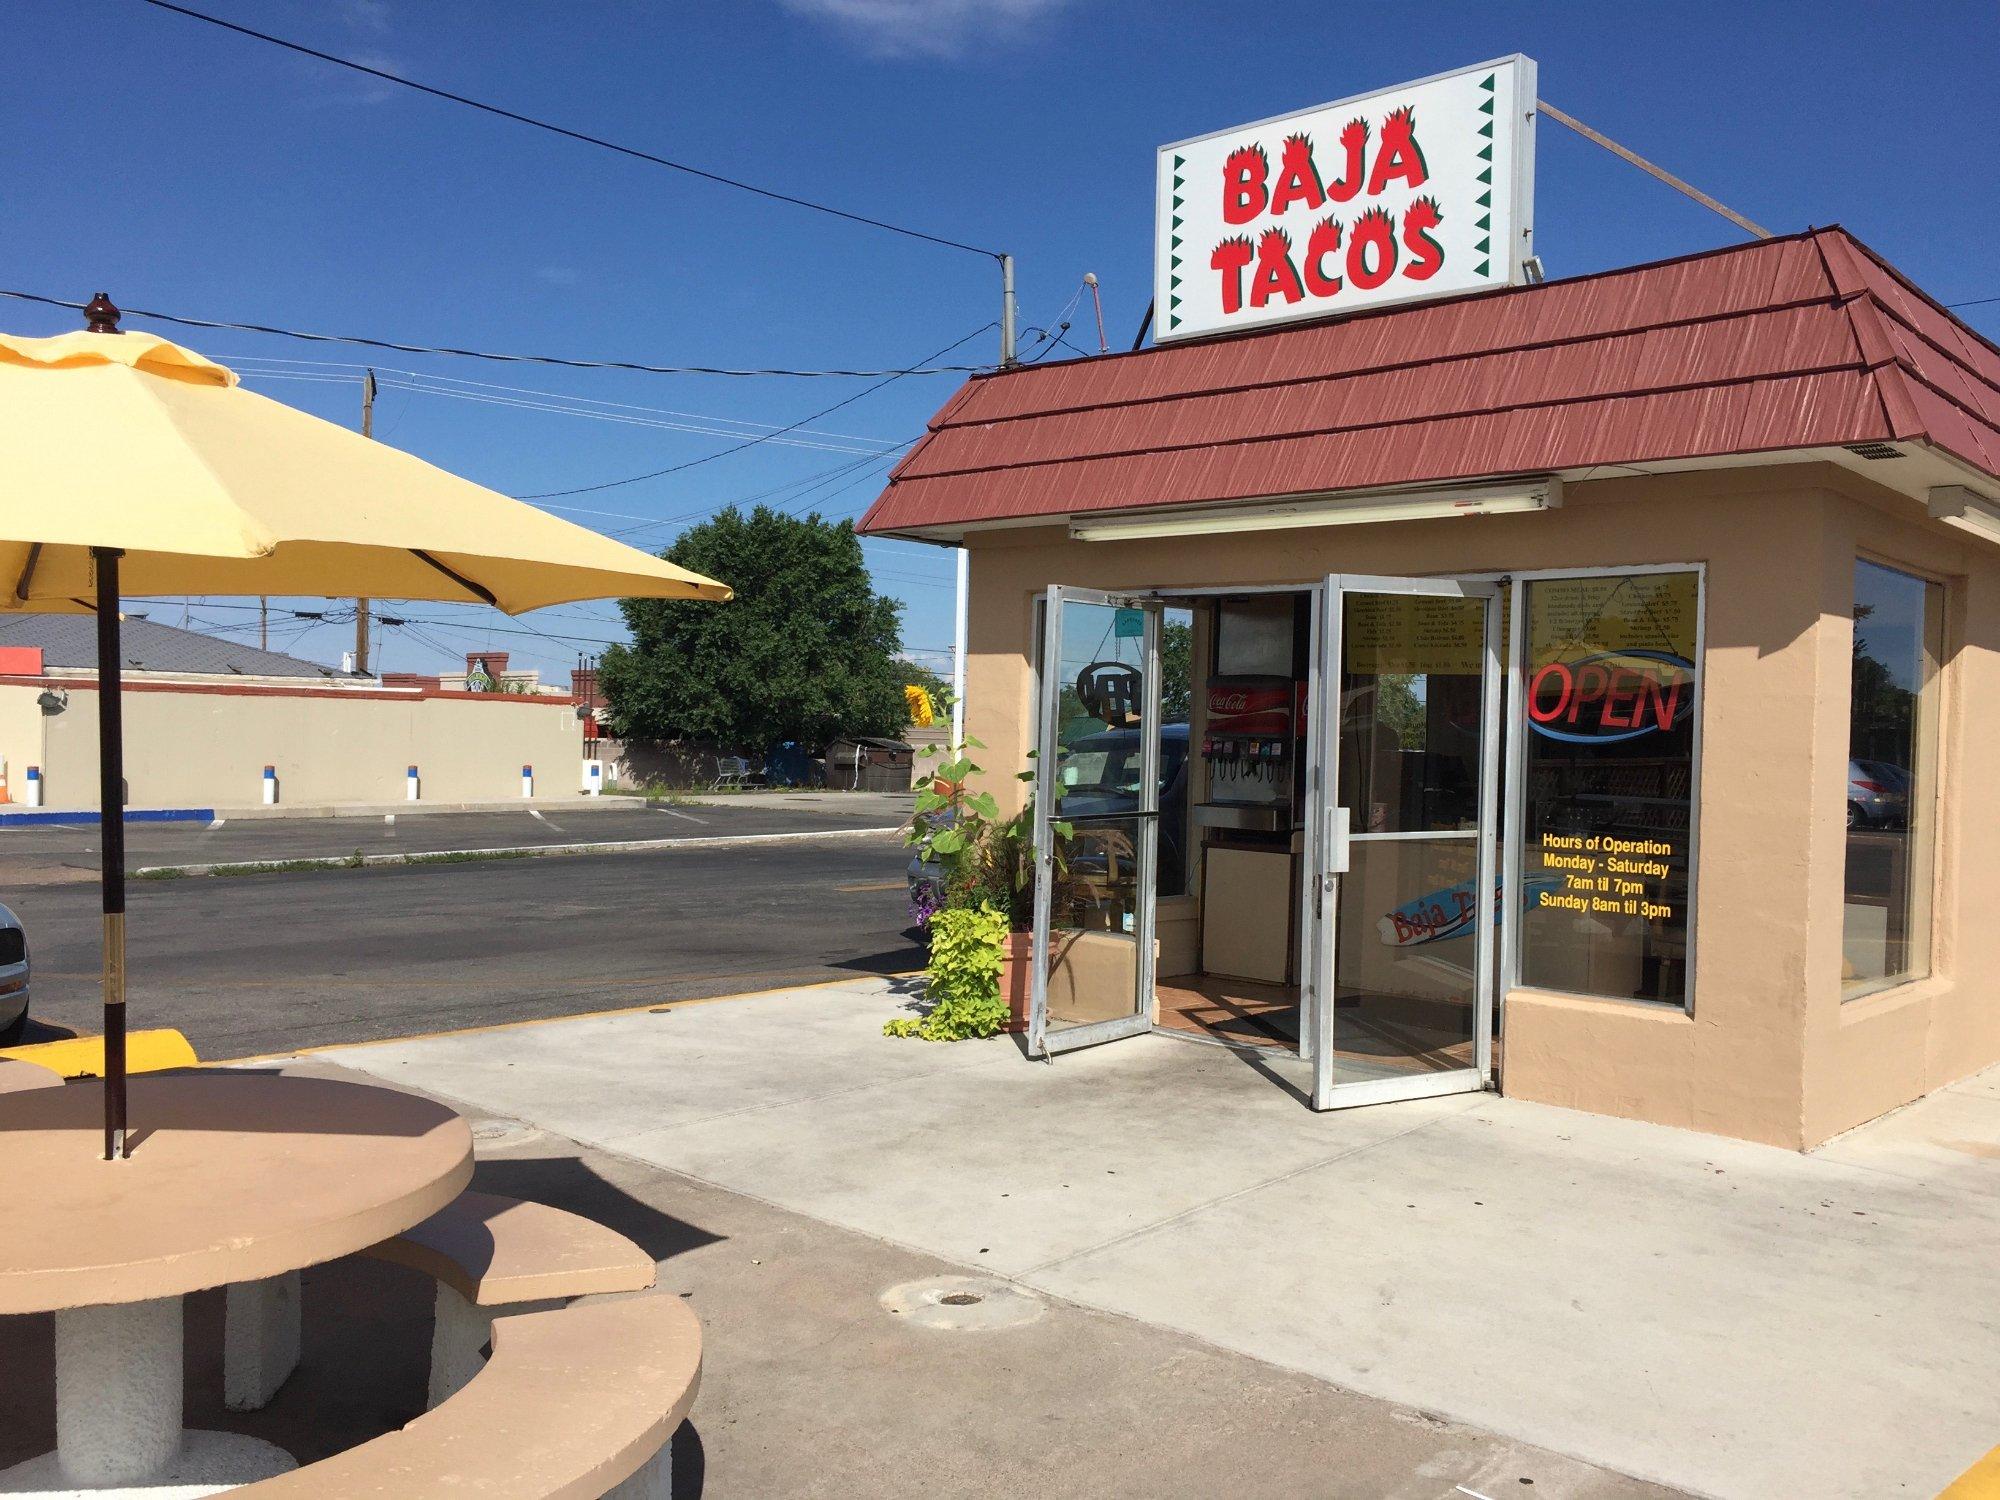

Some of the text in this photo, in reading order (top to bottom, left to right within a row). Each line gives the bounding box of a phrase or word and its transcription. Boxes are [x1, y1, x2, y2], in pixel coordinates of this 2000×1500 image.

[1222, 105, 1429, 224] BAJA
[1210, 194, 1445, 314] TACOS
[1529, 663, 1682, 731] OPEN
[1543, 833, 1671, 855] Hours of Operation
[1543, 852, 1595, 873] Monday
[1607, 857, 1669, 879] Saturday
[1566, 874, 1644, 896] 7am til 7pm
[1540, 892, 1589, 913] Sunday
[1592, 897, 1620, 912] 8am
[1624, 899, 1637, 914] til
[1641, 902, 1671, 919] 3pm
[1392, 902, 1447, 944] Baja
